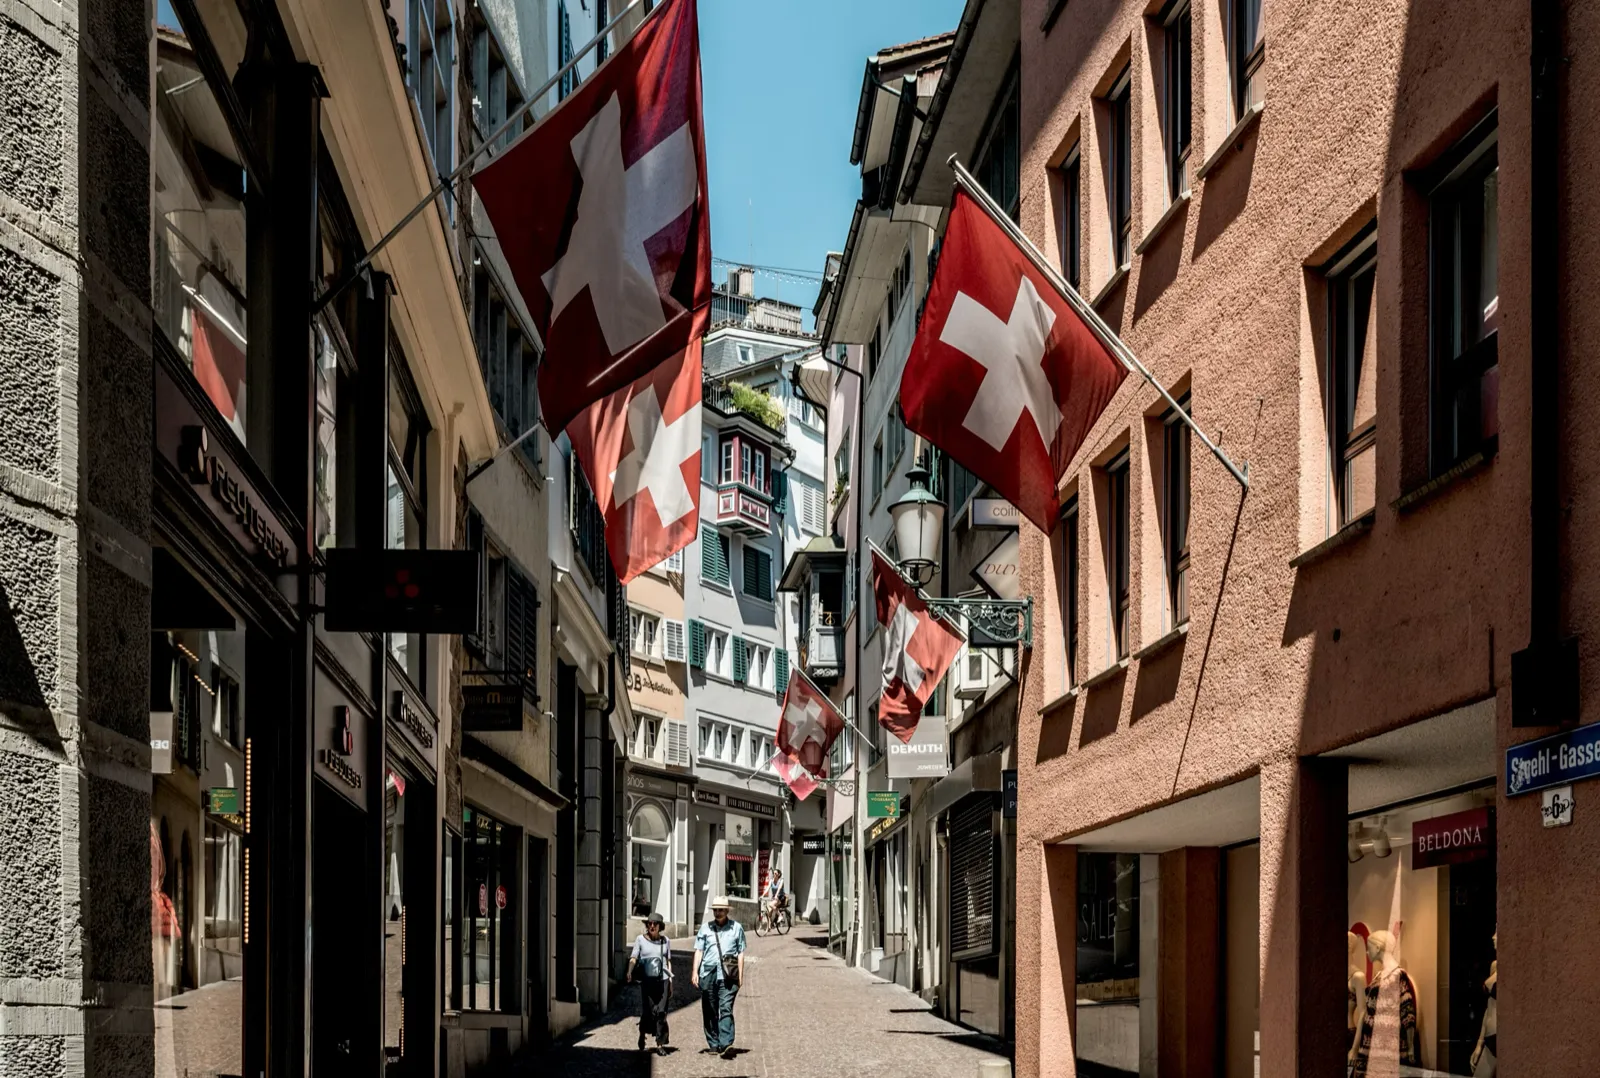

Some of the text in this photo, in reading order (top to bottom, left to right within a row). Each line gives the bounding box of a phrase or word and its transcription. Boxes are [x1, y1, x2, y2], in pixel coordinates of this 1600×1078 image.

[984, 563, 1020, 575] DUY
[890, 743, 943, 754] DEMUTH
[1511, 740, 1600, 783] Strehl-Gasse
[1552, 794, 1560, 818] 6
[1419, 824, 1482, 853] BELDONA
[1081, 897, 1115, 943] SALE
